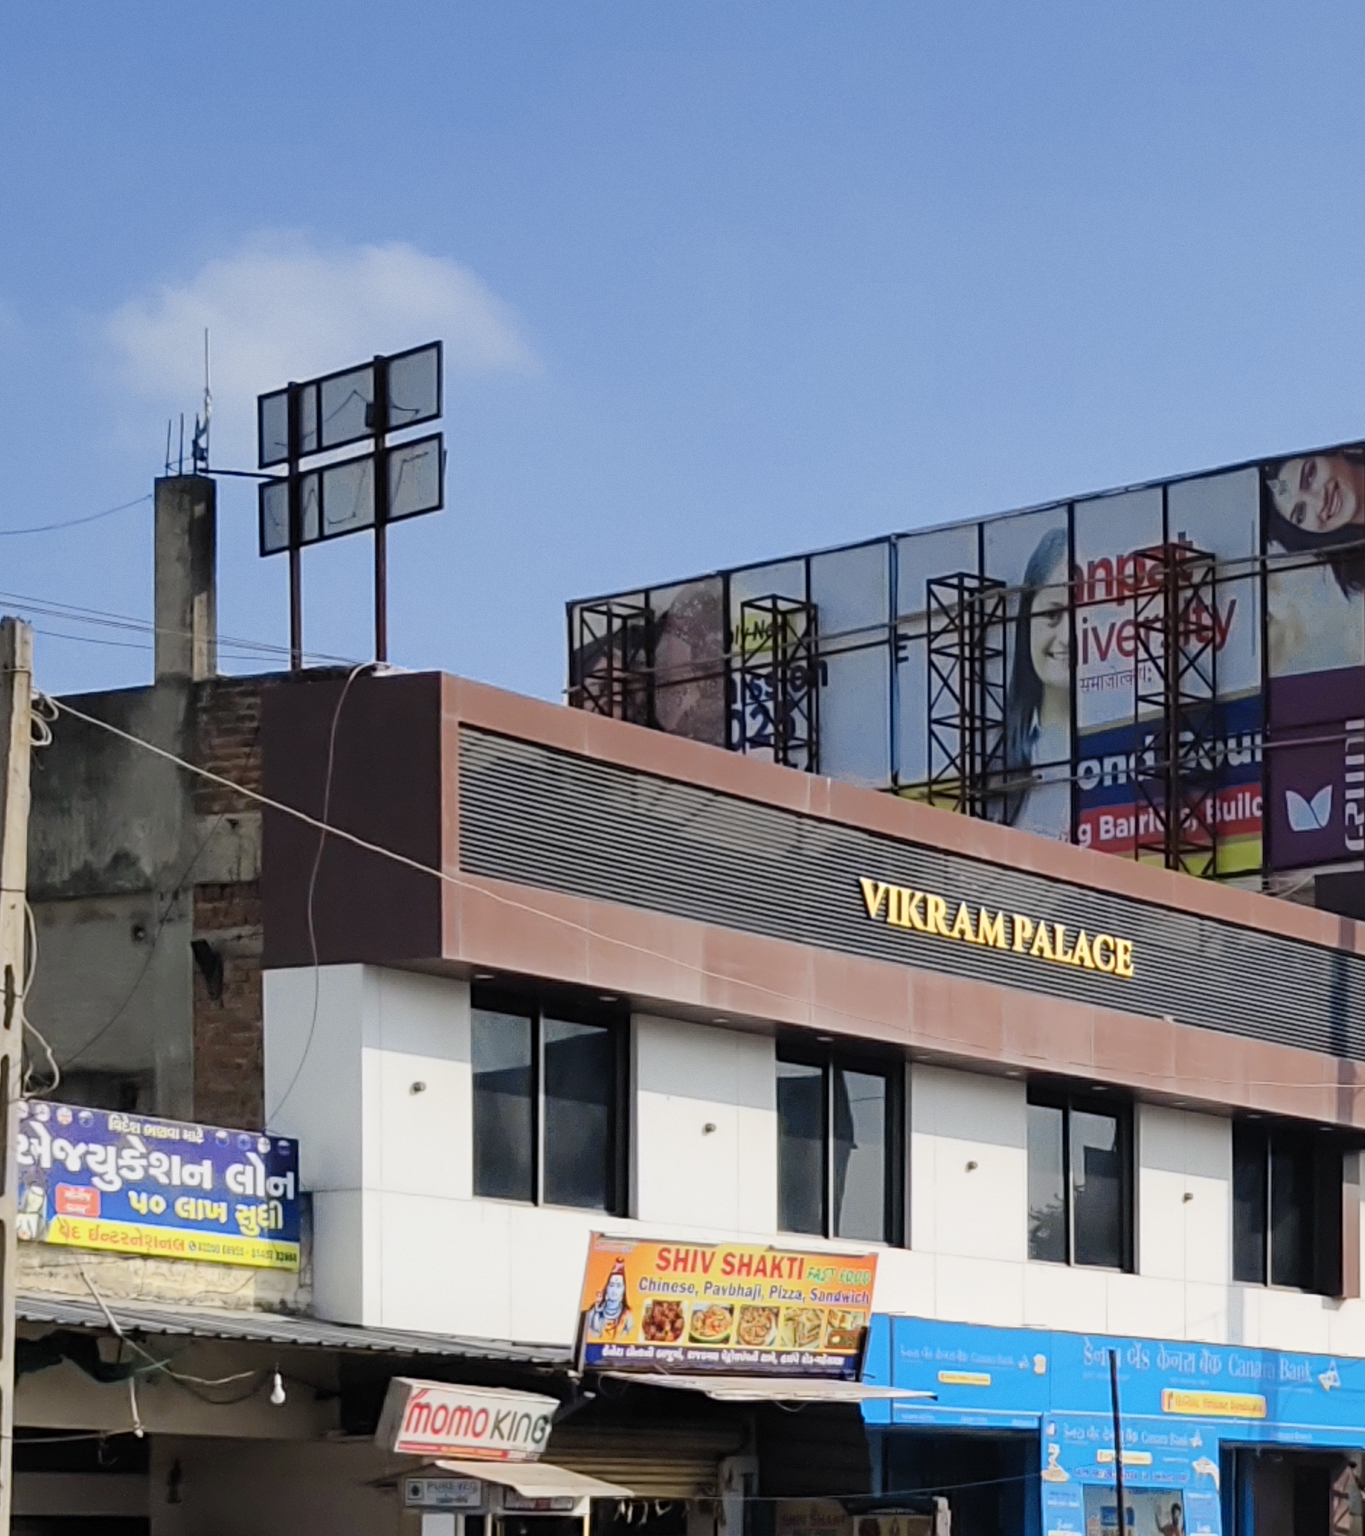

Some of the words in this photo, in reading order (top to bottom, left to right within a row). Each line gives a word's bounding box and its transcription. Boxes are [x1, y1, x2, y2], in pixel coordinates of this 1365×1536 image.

[859, 877, 1008, 950] VIKRAM
[1012, 914, 1134, 977] PALACE
[225, 1152, 295, 1200] લોન
[175, 1197, 228, 1224] લાખ
[235, 1202, 284, 1238] સુધી
[655, 1247, 716, 1275] SHIV
[720, 1252, 806, 1281] SHAKTI
[807, 1266, 836, 1283] FAST
[838, 1269, 871, 1285] FOOD
[638, 1277, 699, 1297] Chinese,
[809, 1288, 870, 1306] Sandwich
[1227, 1357, 1276, 1380] Canara
[1279, 1361, 1313, 1383] Bank
[404, 1393, 489, 1439] MOMO
[489, 1408, 551, 1444] KING
